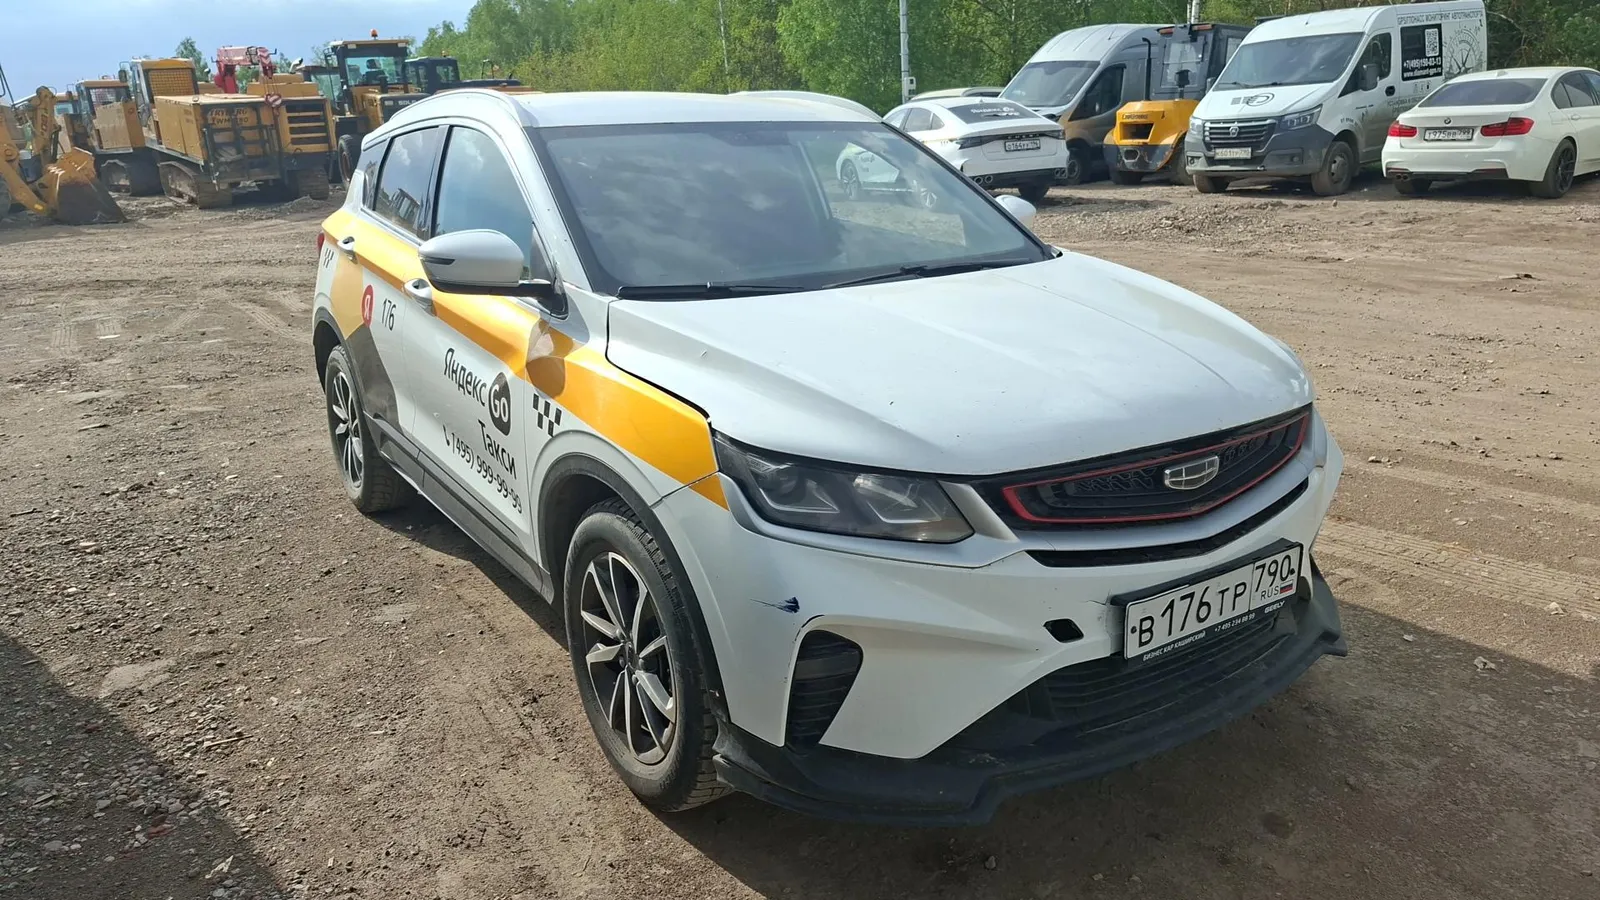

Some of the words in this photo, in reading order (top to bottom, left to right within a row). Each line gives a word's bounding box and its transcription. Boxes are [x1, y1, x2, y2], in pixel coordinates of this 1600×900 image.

[381, 298, 396, 331] 176
[443, 347, 487, 407] Яндекс
[490, 384, 510, 423] Go
[478, 418, 517, 480] Такси
[1254, 554, 1292, 593] 790
[1260, 588, 1280, 601] RUS
[1264, 600, 1286, 614] GEELY
